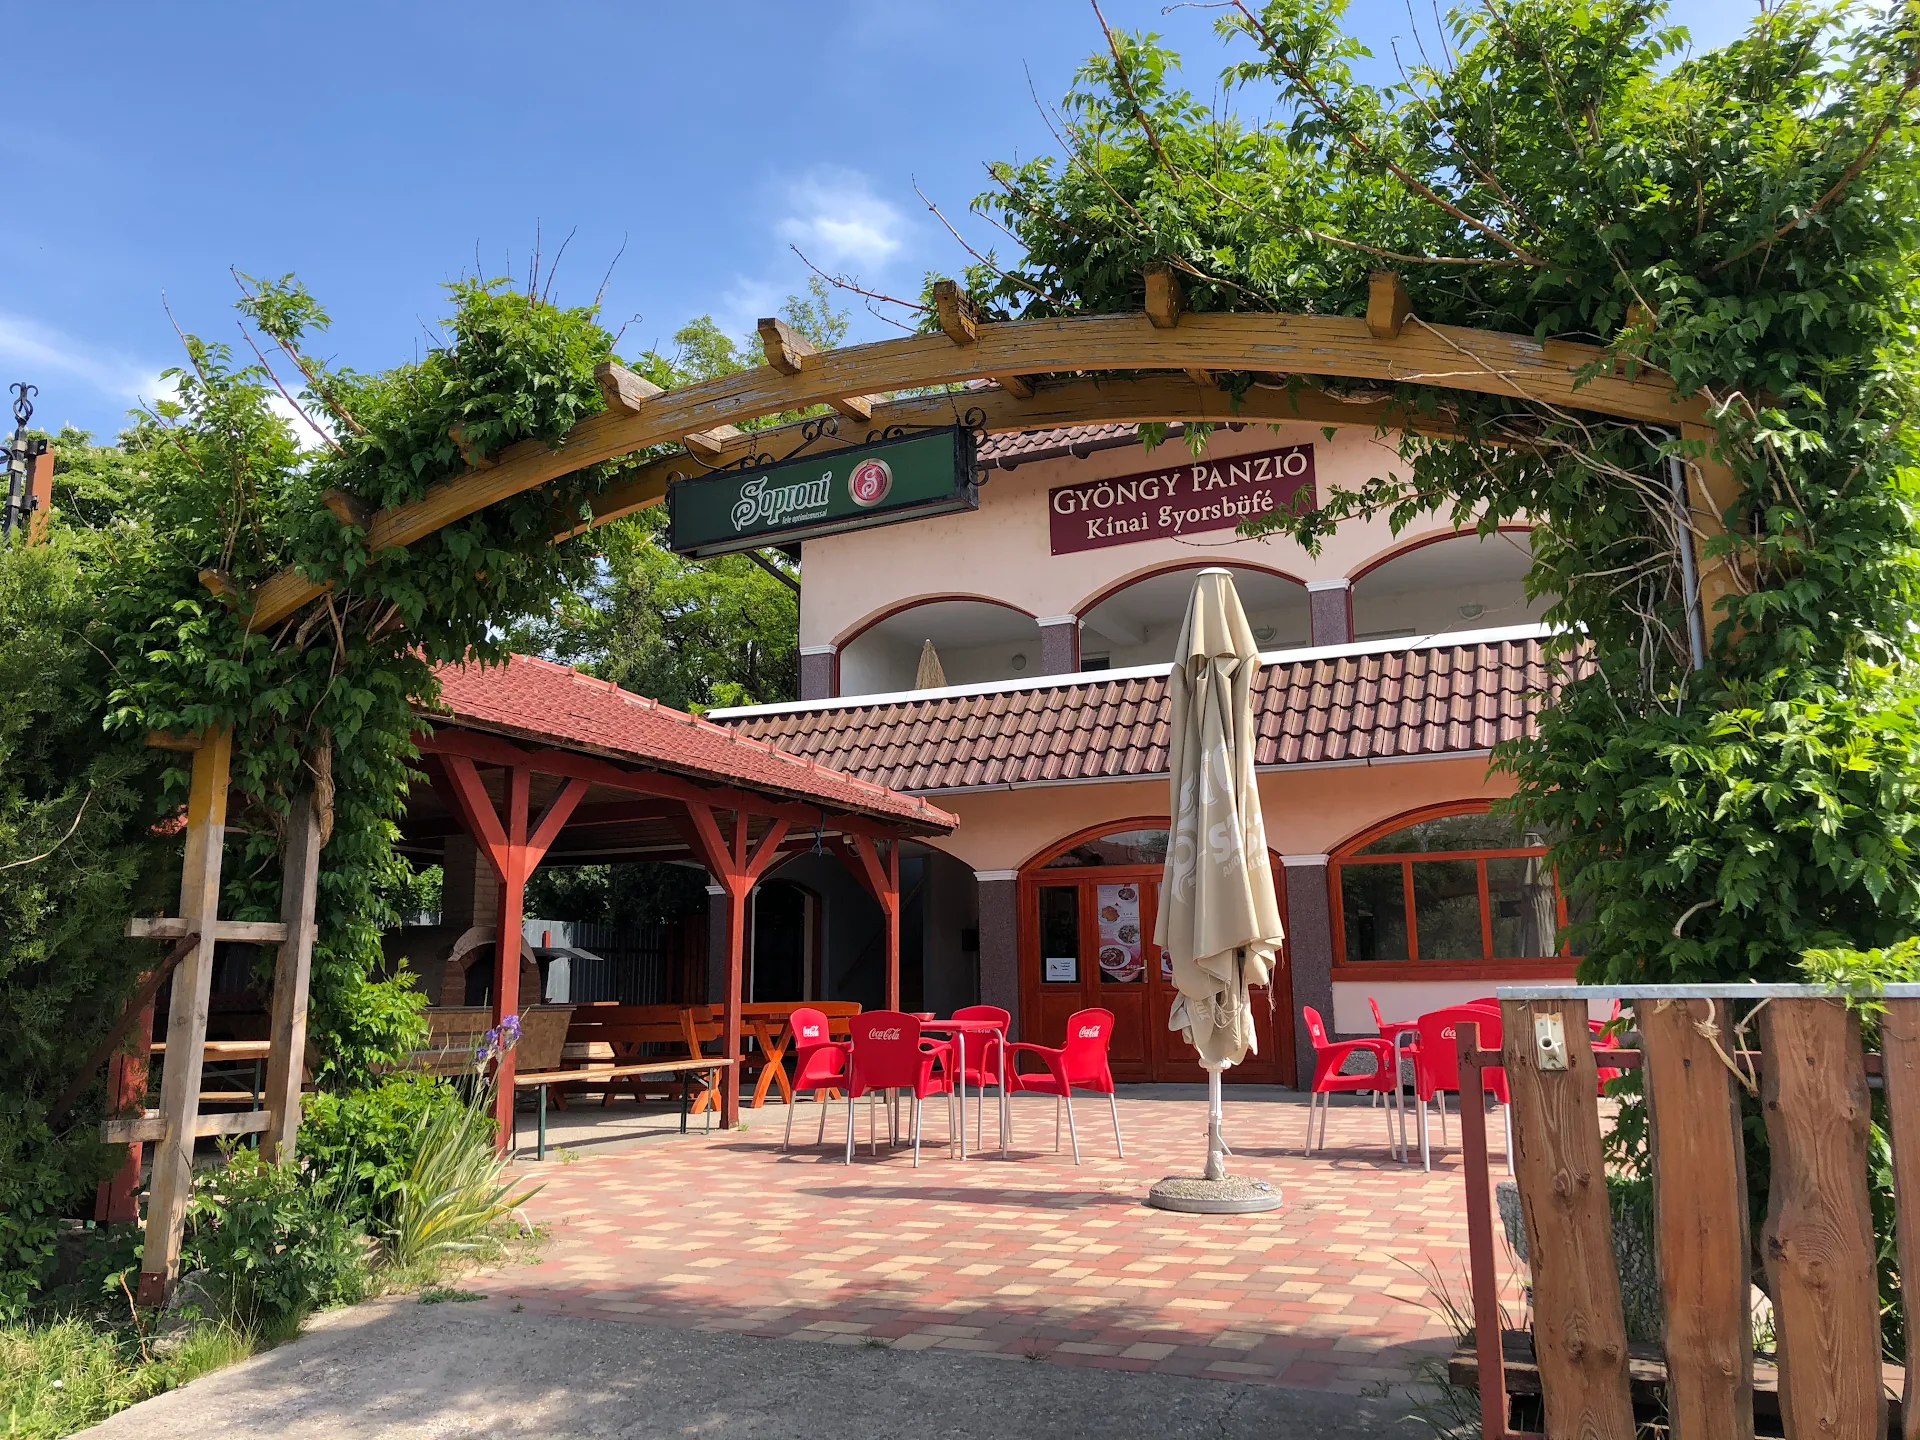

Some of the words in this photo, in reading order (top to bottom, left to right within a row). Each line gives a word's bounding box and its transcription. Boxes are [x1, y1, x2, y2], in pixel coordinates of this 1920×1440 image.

[731, 470, 833, 531] Soproni
[1053, 473, 1182, 515] GYÖNGY
[1191, 446, 1308, 493] PANZIÓ
[1086, 511, 1150, 540] Kínai
[1158, 489, 1274, 533] gyorsbüfé
[868, 1027, 902, 1041] Coca-Cola
